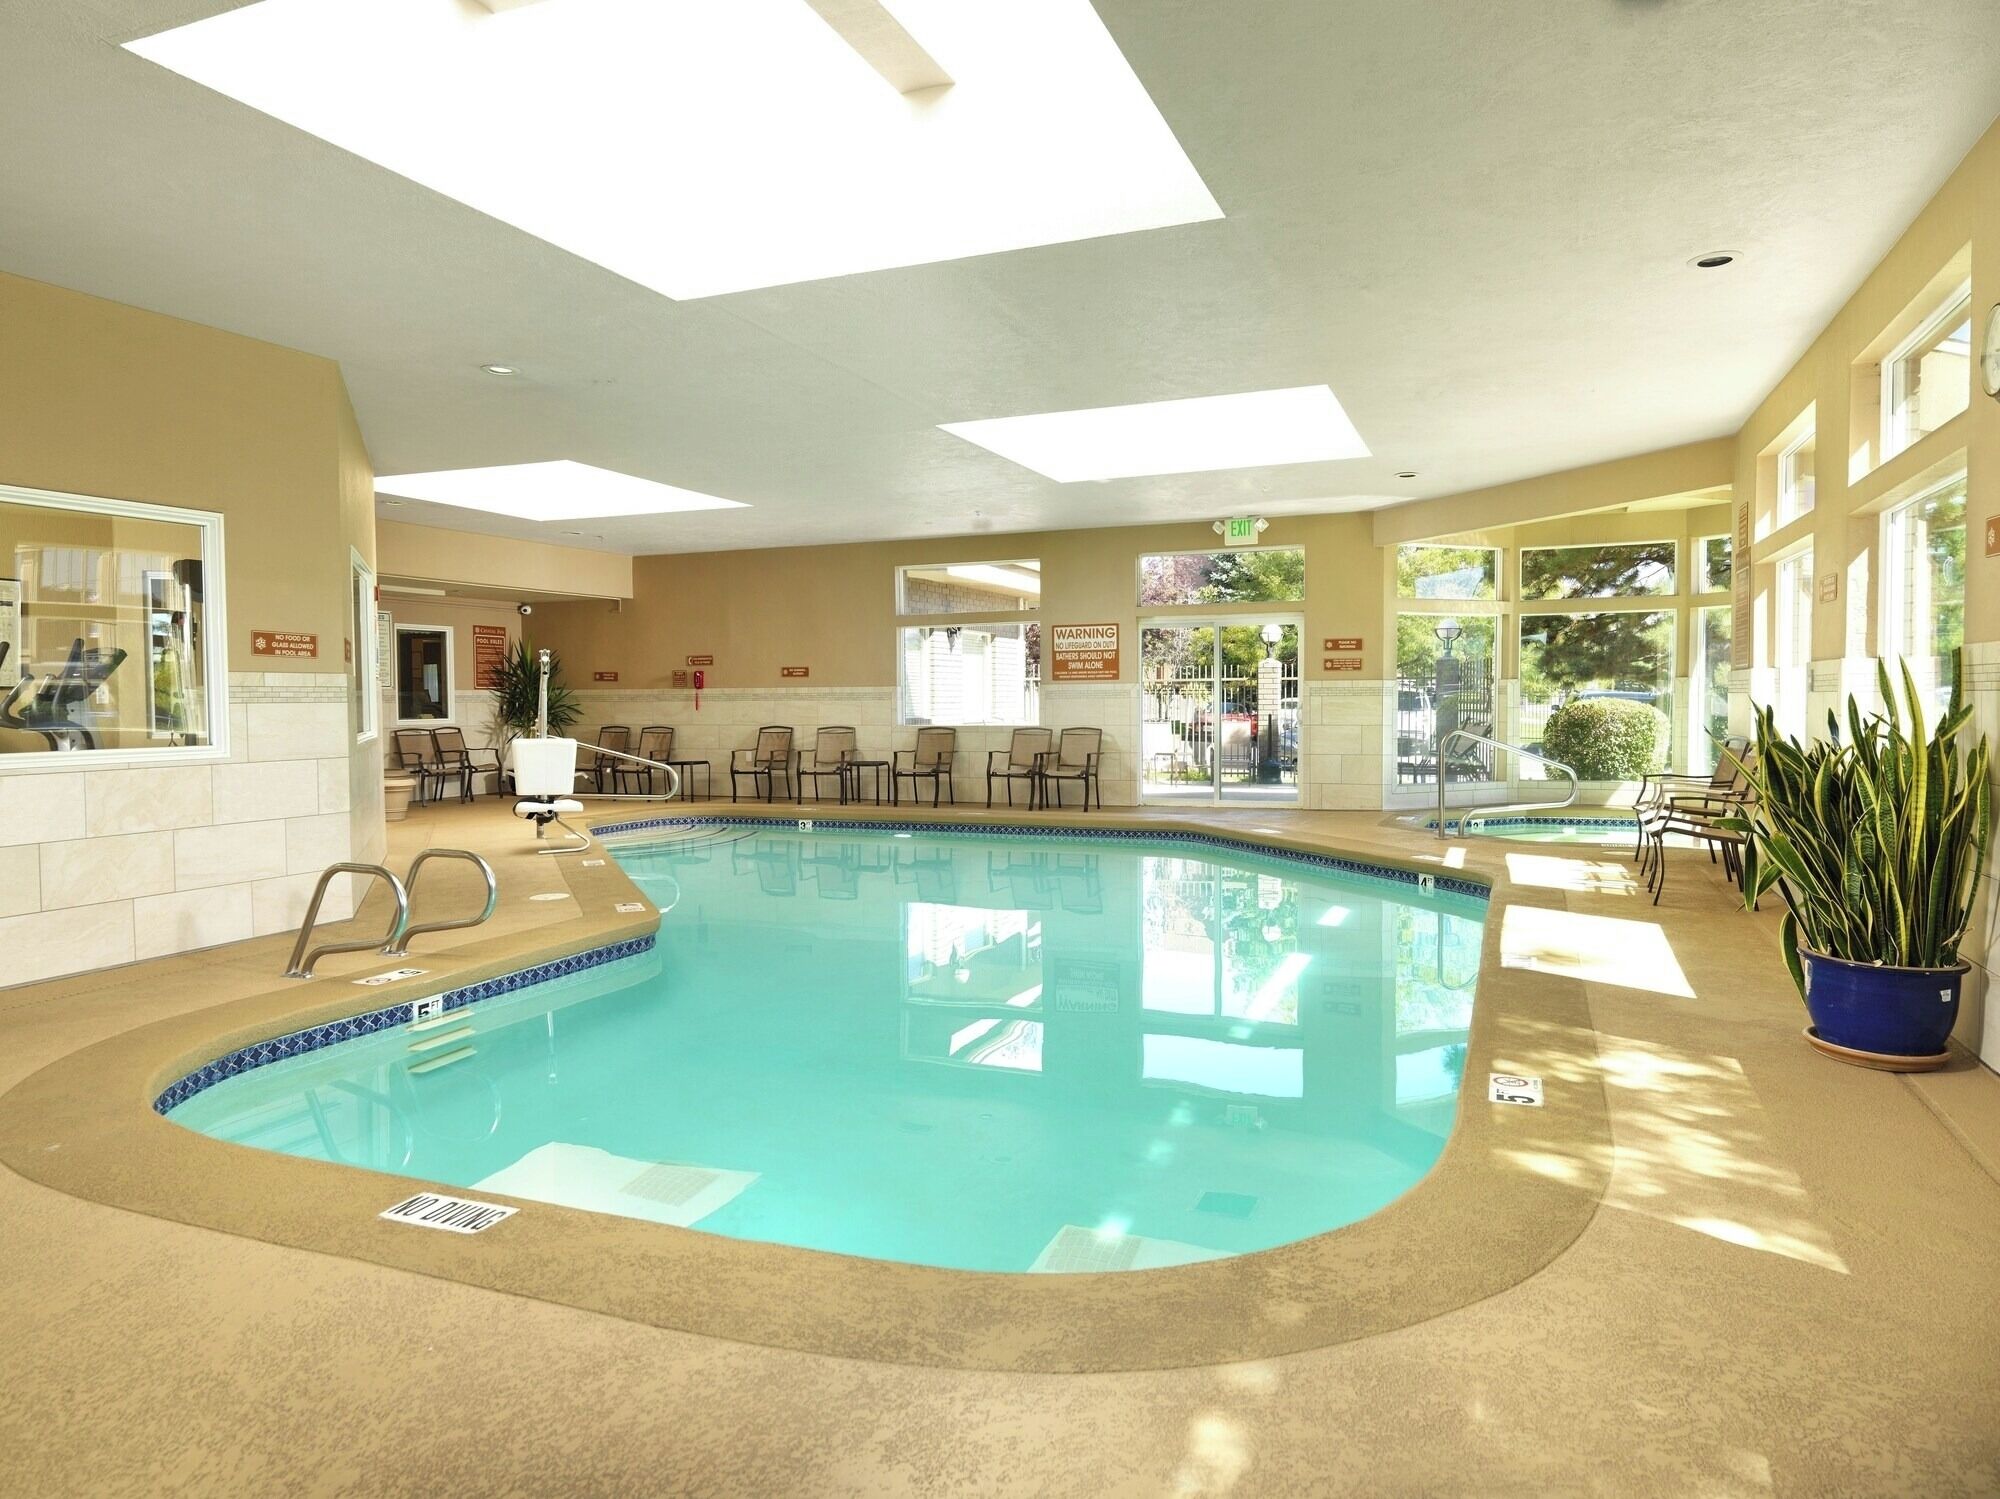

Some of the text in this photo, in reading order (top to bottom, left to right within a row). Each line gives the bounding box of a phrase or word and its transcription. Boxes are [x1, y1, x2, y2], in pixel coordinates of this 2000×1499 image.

[1231, 519, 1251, 537] EXIT
[1056, 627, 1115, 640] WARNING
[289, 642, 314, 650] ALLOWED
[1055, 640, 1116, 650] NO LIFEGUARD ON DUTY
[1055, 651, 1116, 661] BATHERS SHOULD NOT
[1068, 661, 1104, 670] SWIM ALONE
[418, 1000, 440, 1018] 5 FT
[1496, 1094, 1535, 1104] 5
[387, 1195, 507, 1230] NO DIVING
